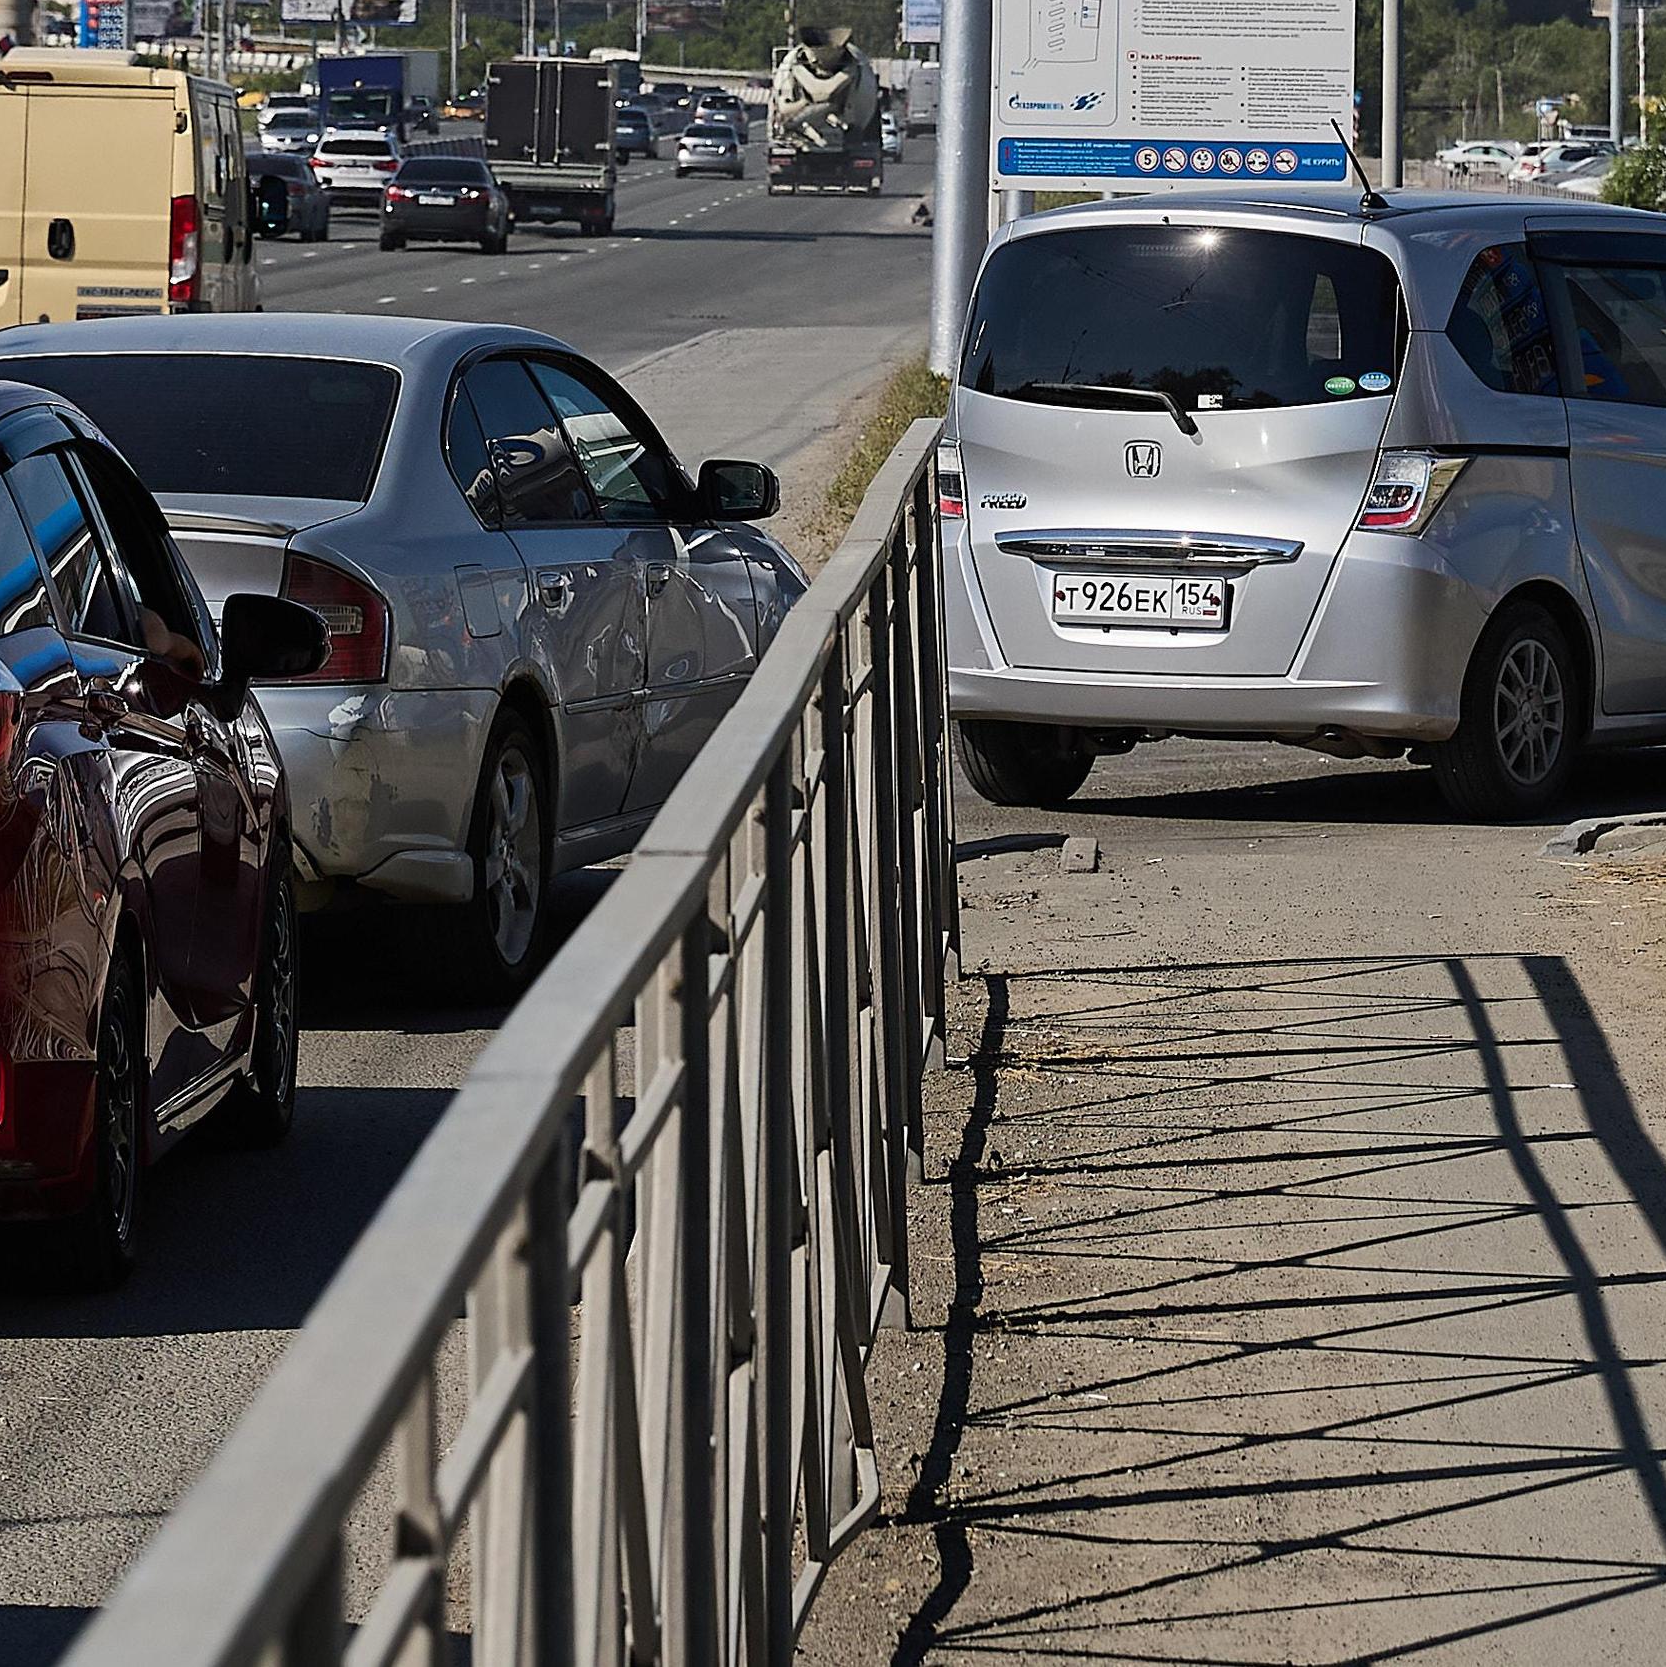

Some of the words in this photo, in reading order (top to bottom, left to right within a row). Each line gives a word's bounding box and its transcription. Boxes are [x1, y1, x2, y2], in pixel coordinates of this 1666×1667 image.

[1143, 153, 1153, 166] 5
[1301, 157, 1312, 165] НЕ
[1313, 157, 1343, 167] КУРИТЬ!
[1065, 581, 1169, 614] Т926ЕК
[1175, 582, 1216, 607] 154
[1182, 606, 1202, 616] RUS
